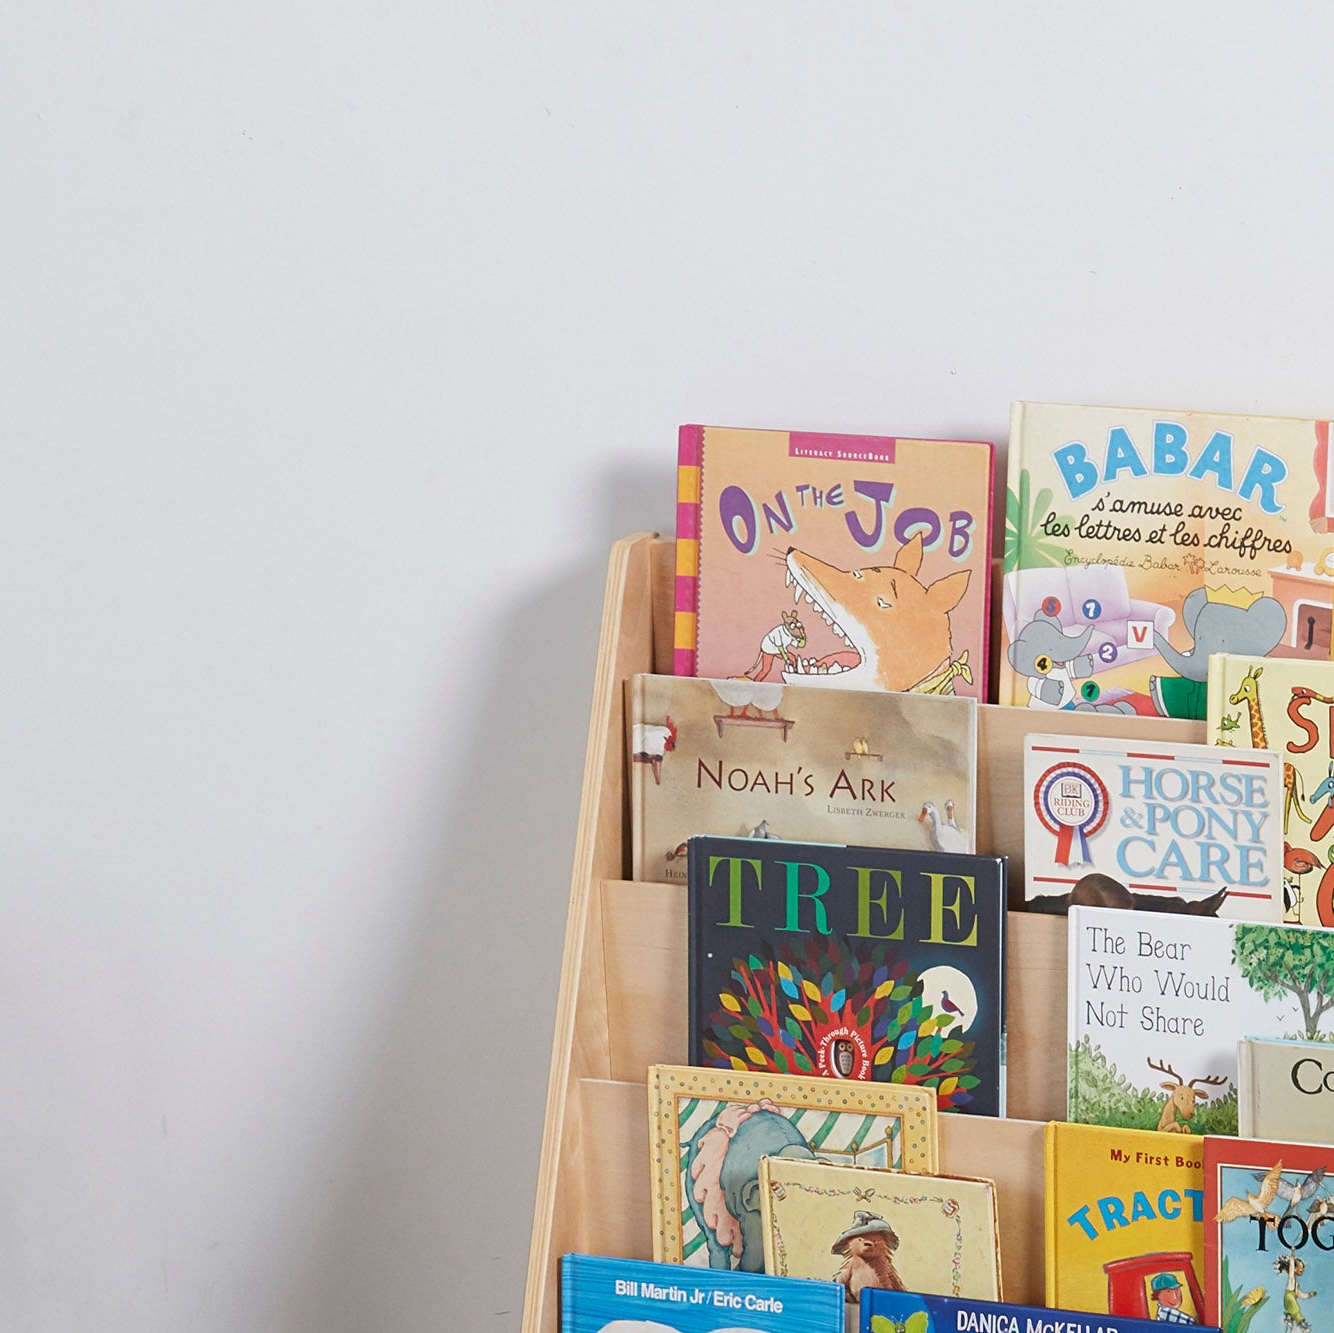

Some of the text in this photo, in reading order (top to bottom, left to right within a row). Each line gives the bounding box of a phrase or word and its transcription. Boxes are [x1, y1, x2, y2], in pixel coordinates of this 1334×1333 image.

[1051, 420, 1289, 515] BABAR
[719, 480, 974, 558] ON THE JOB
[1092, 492, 1243, 522] s'amuse avec
[1040, 512, 1293, 560] les lettres et les chiffres
[1138, 554, 1182, 571] Babar
[1203, 560, 1263, 577] Larousse
[1132, 626, 1147, 643] V
[1036, 657, 1048, 671] 4
[1101, 645, 1114, 660] 2
[696, 757, 897, 803] NOAH'S ARK
[1118, 764, 1270, 808] HORSE
[865, 808, 907, 820] ZWERGER
[1054, 797, 1090, 808] RIDING
[1057, 806, 1085, 817] CLUB
[1145, 801, 1271, 843] PONY
[1116, 835, 1271, 888] CARE
[708, 856, 978, 947] TREE
[1086, 926, 1192, 961] The Bear
[1085, 963, 1230, 1002] Who Would
[1085, 1000, 1205, 1037] Not Share
[850, 1030, 868, 1058] Picture
[857, 1059, 870, 1080] Book
[1110, 1148, 1205, 1169] My First Boo
[1067, 1189, 1205, 1241] TRACT
[615, 1279, 638, 1297] Bill
[640, 1282, 687, 1303] Martin
[689, 1288, 704, 1304] Jr
[713, 1291, 742, 1309] Eric
[744, 1294, 784, 1314] Carle
